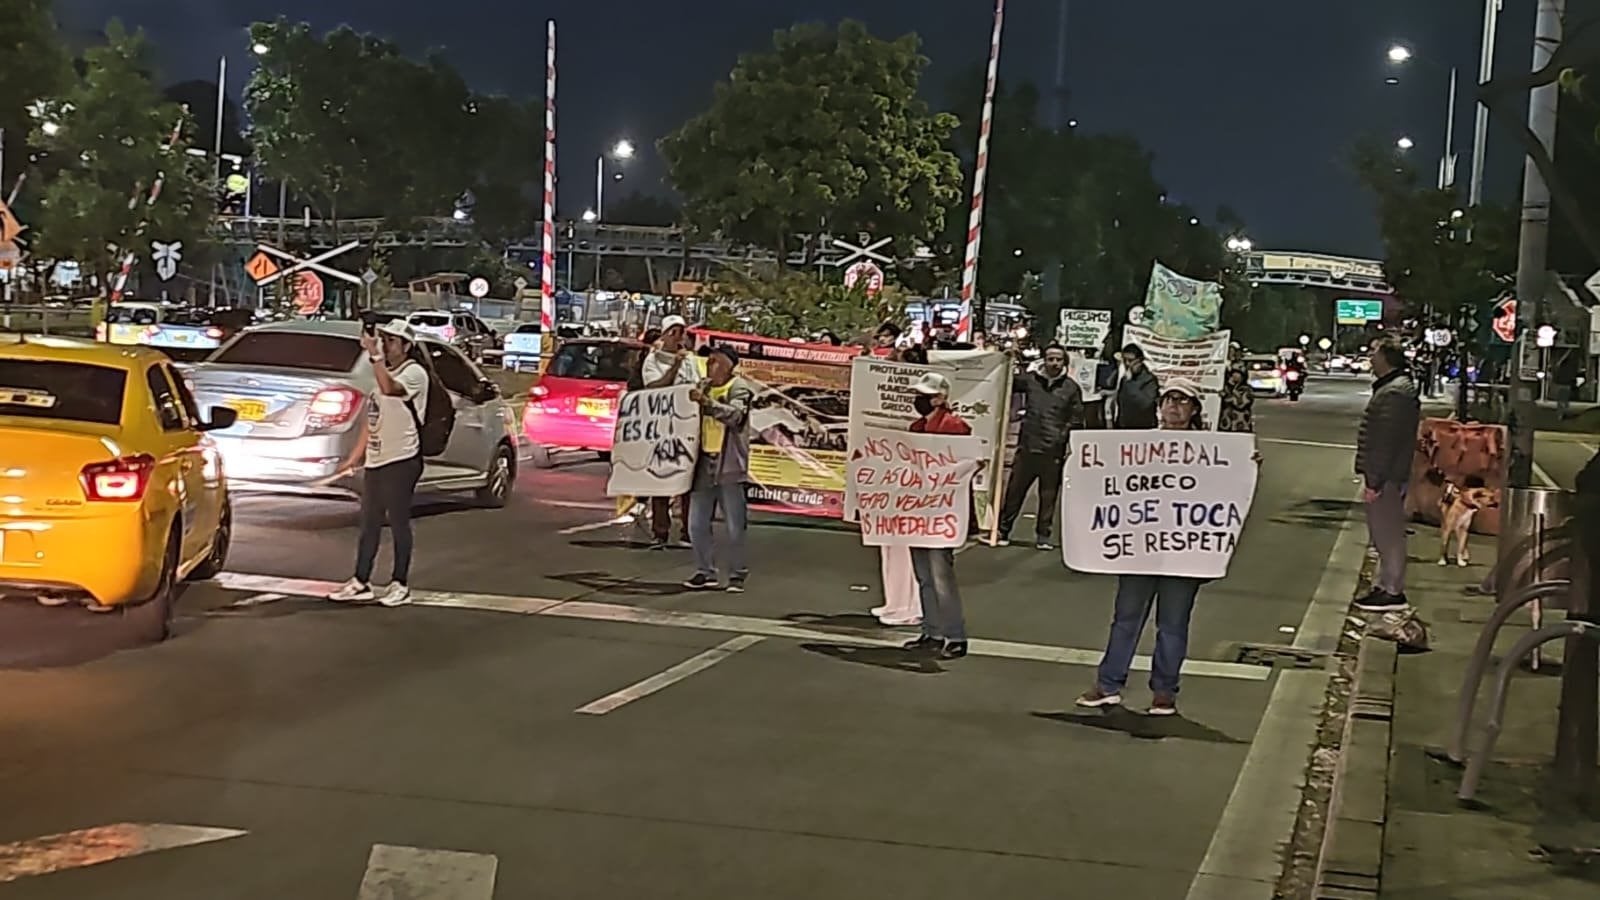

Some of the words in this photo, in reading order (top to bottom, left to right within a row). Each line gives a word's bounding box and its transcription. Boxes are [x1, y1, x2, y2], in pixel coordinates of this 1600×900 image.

[887, 375, 910, 385] AVES
[619, 393, 640, 417] LA
[623, 420, 642, 441] ES
[645, 420, 661, 441] EL
[864, 436, 893, 462] NOS
[1081, 443, 1105, 468] EL
[1120, 441, 1229, 467] HUMEDAL
[1104, 476, 1121, 496] EL
[1126, 474, 1196, 492] GRECO
[792, 492, 824, 505] verde
[876, 513, 958, 539] HUMEDALES
[1091, 503, 1121, 531] NO
[1127, 499, 1160, 525] SE
[1172, 502, 1241, 527] TOCA
[1102, 533, 1134, 560] SE
[1145, 531, 1236, 554] RESPETA
